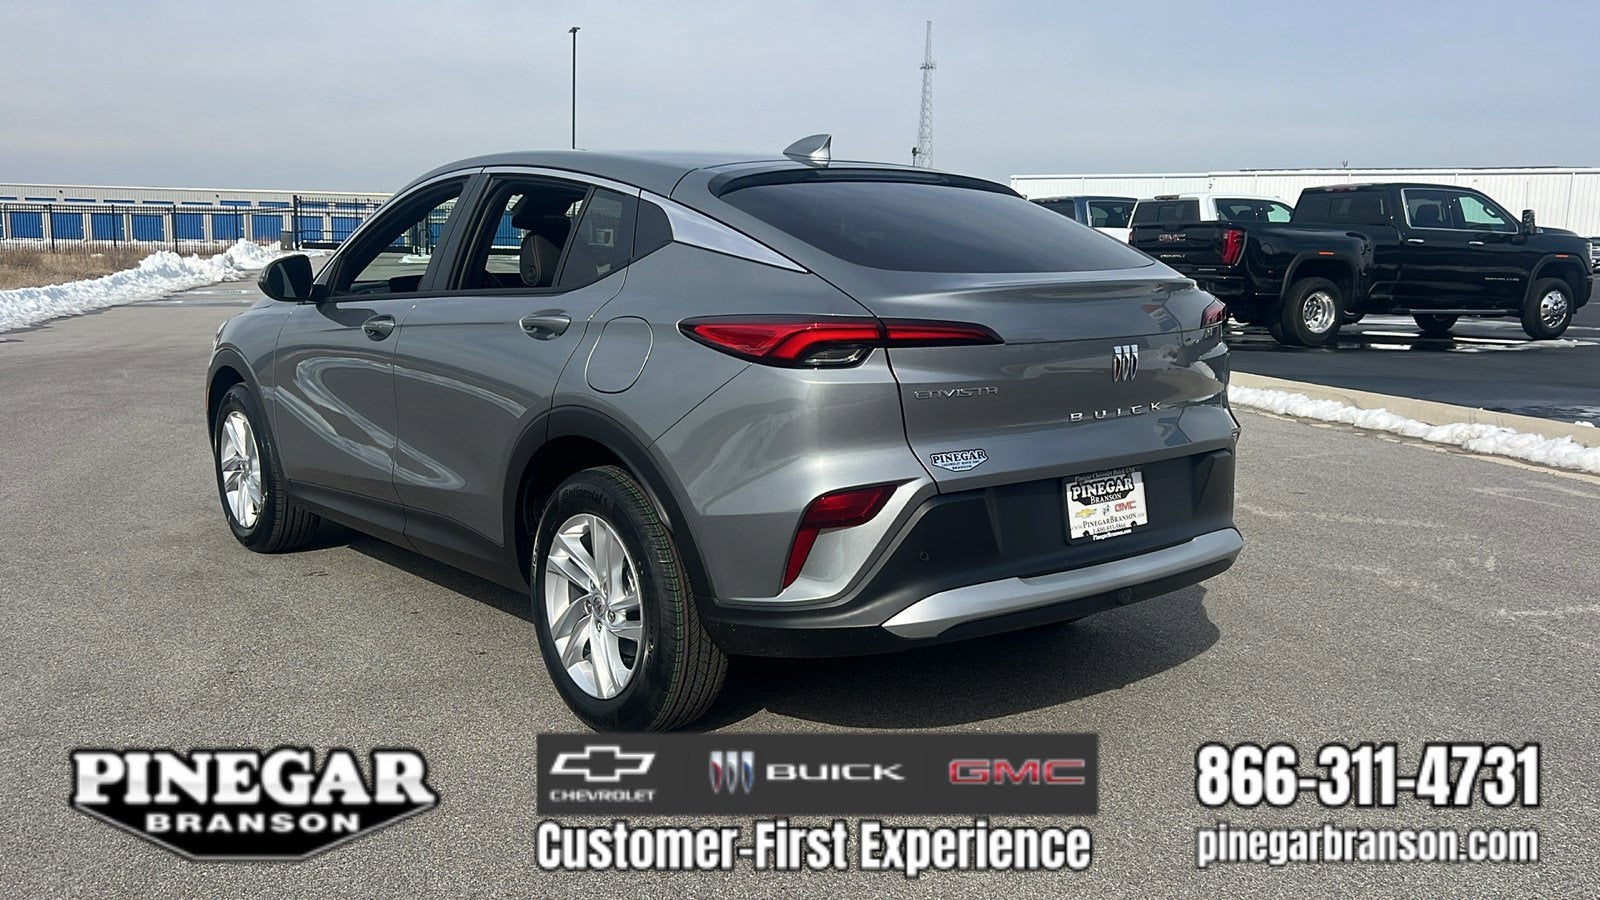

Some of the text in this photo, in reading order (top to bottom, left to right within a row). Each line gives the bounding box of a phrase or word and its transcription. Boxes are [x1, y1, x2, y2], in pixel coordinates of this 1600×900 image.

[914, 385, 999, 400] ENVISTA
[1070, 401, 1161, 421] BUICK
[932, 451, 986, 464] PINEGAR
[1071, 477, 1133, 500] PINEGAR
[1090, 493, 1122, 505] BRANSON
[1114, 500, 1137, 513] GMC
